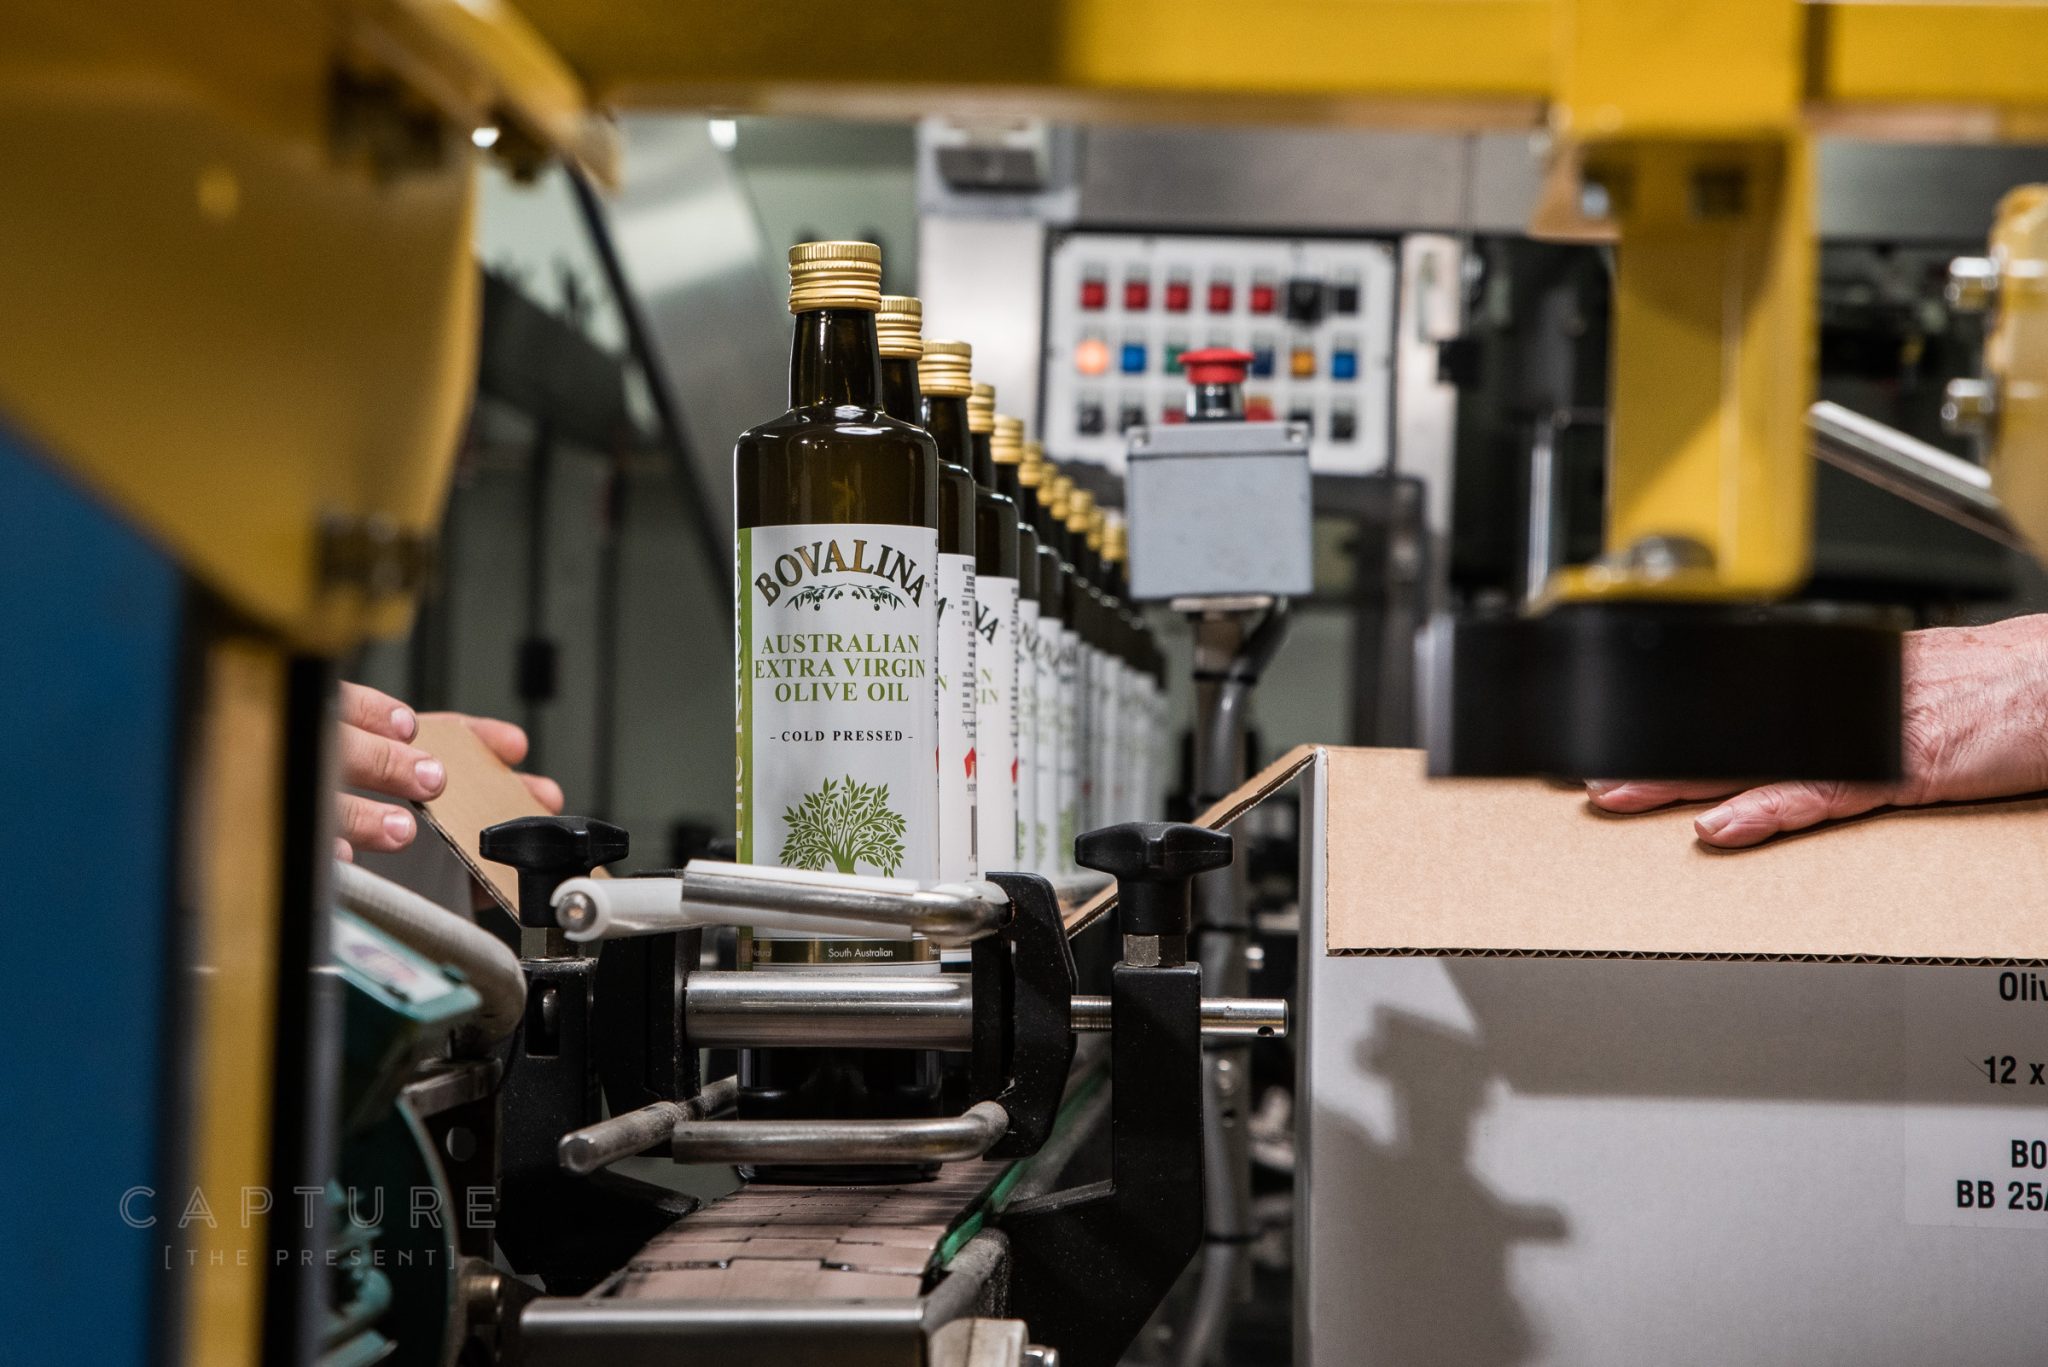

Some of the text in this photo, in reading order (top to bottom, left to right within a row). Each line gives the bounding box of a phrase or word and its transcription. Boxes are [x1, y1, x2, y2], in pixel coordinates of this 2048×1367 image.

[754, 539, 925, 607] BOVALINA
[761, 633, 920, 654] AUSTRALIAN
[754, 658, 926, 678] EXTRA VIRGIN
[774, 683, 909, 702] OLIVE OIL
[781, 730, 825, 742] COLD
[832, 730, 903, 742] PRESSED
[827, 948, 894, 958] South Australian
[1984, 1055, 2046, 1085] 12 x
[1956, 1179, 1996, 1208] BB
